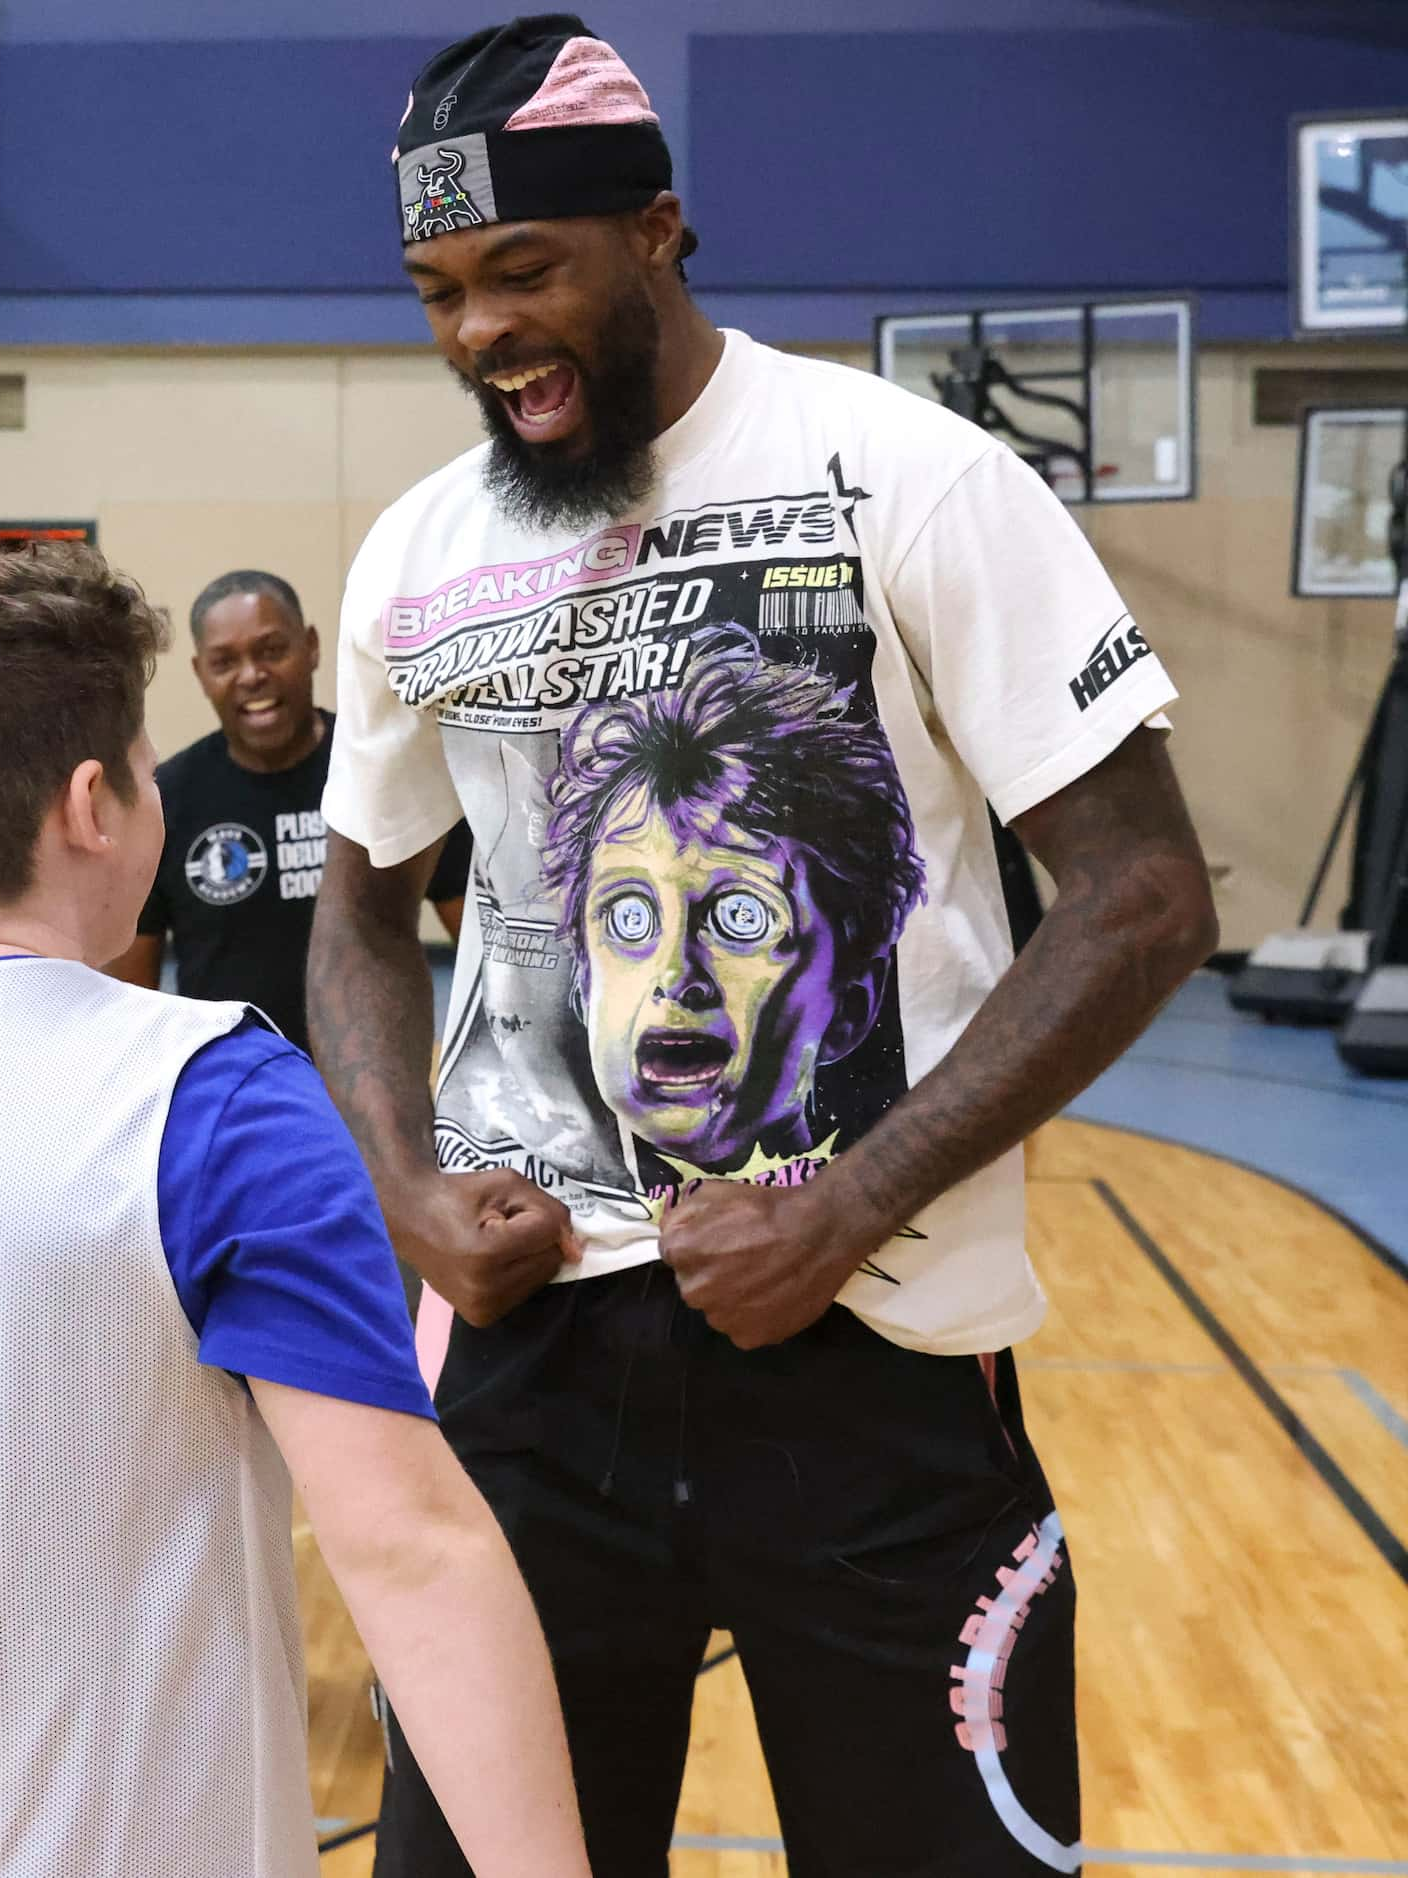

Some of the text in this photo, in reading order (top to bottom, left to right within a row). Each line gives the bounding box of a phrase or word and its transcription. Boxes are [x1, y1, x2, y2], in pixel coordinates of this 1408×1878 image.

[388, 501, 837, 638] BREAKING NEWS
[761, 565, 839, 589] ISSUE
[385, 576, 716, 706] BRAINWASHED
[759, 624, 870, 637] PATH TO PARADISE
[464, 712, 492, 725] CLOSE
[511, 716, 543, 728] EYES!
